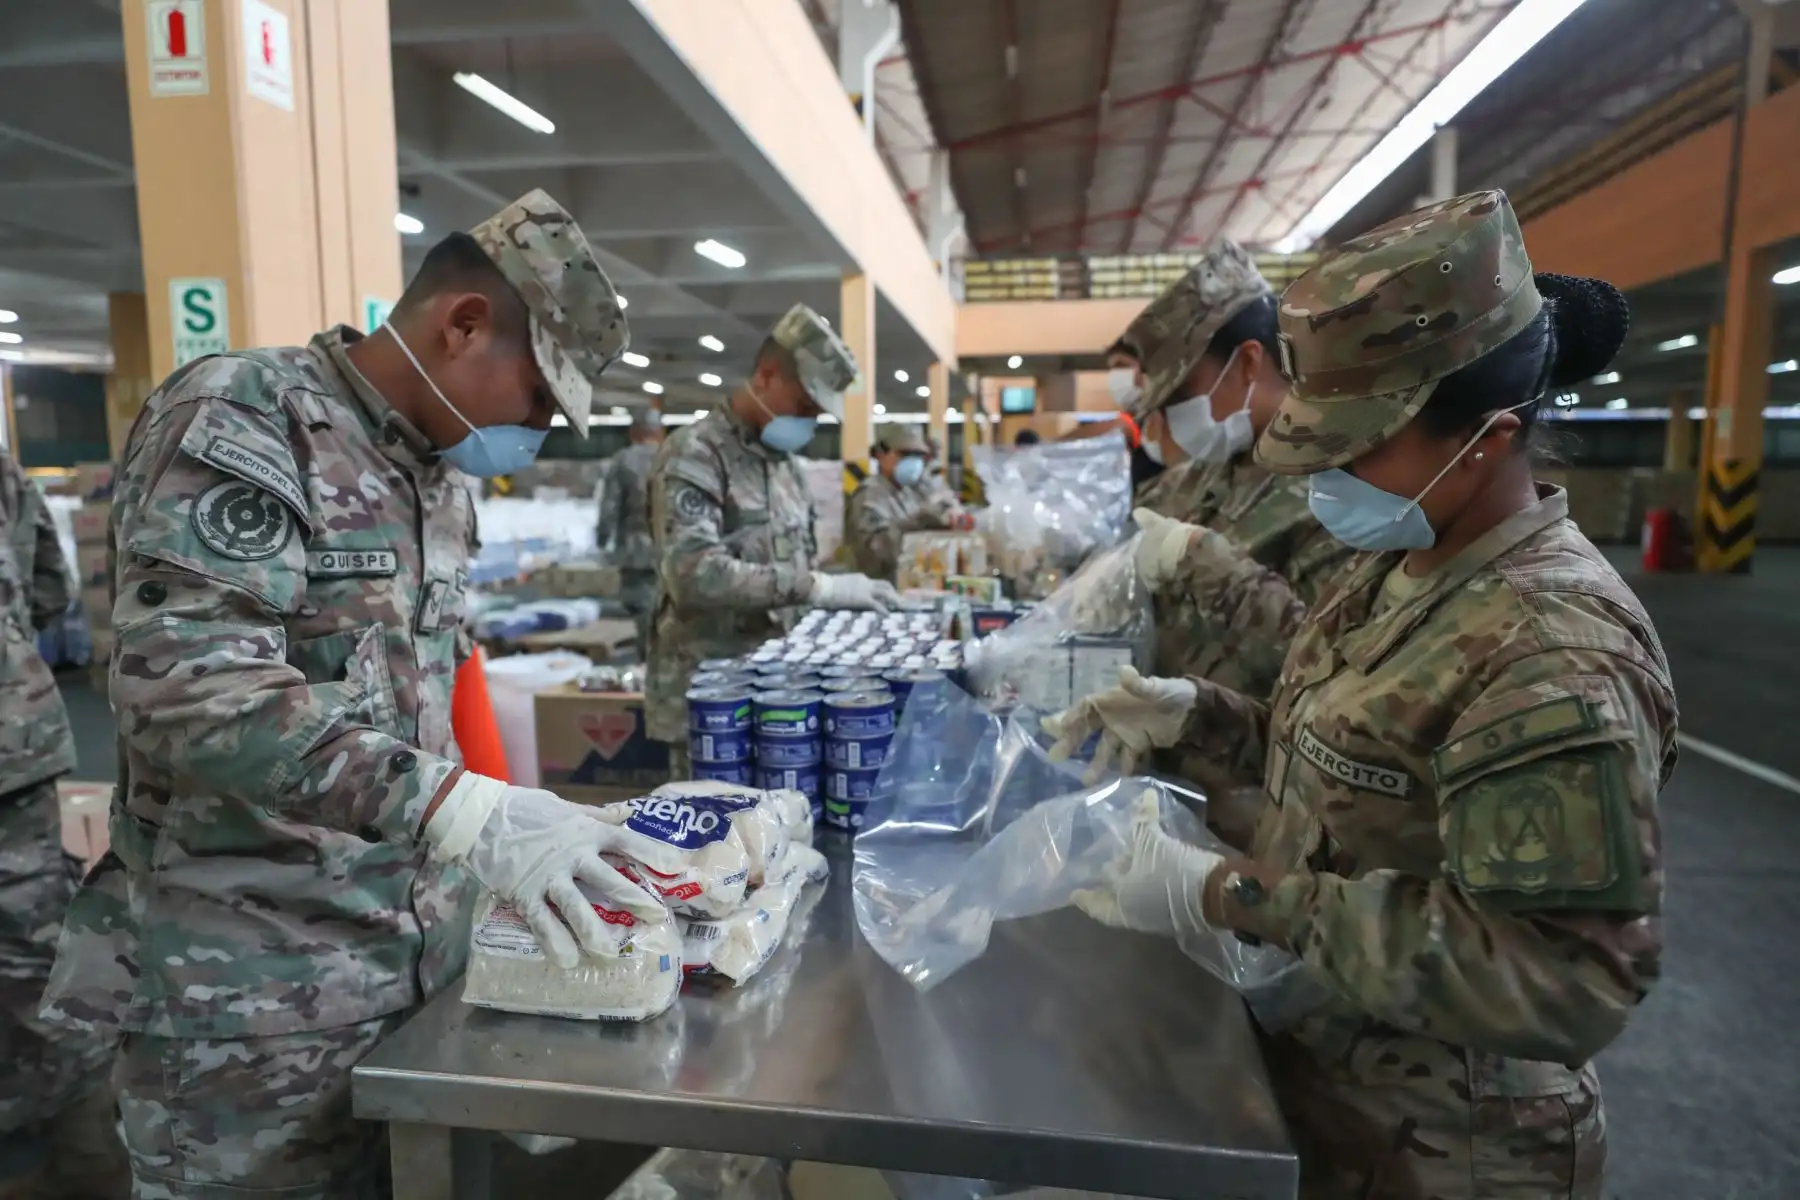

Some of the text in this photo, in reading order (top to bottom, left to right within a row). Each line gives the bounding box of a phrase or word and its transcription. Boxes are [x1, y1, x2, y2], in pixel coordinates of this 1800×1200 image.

[183, 287, 216, 333] S
[214, 443, 270, 476] EJERCITO
[270, 471, 289, 491] DEL
[320, 554, 389, 569] QUISPE
[1300, 735, 1399, 788] EJERCITO
